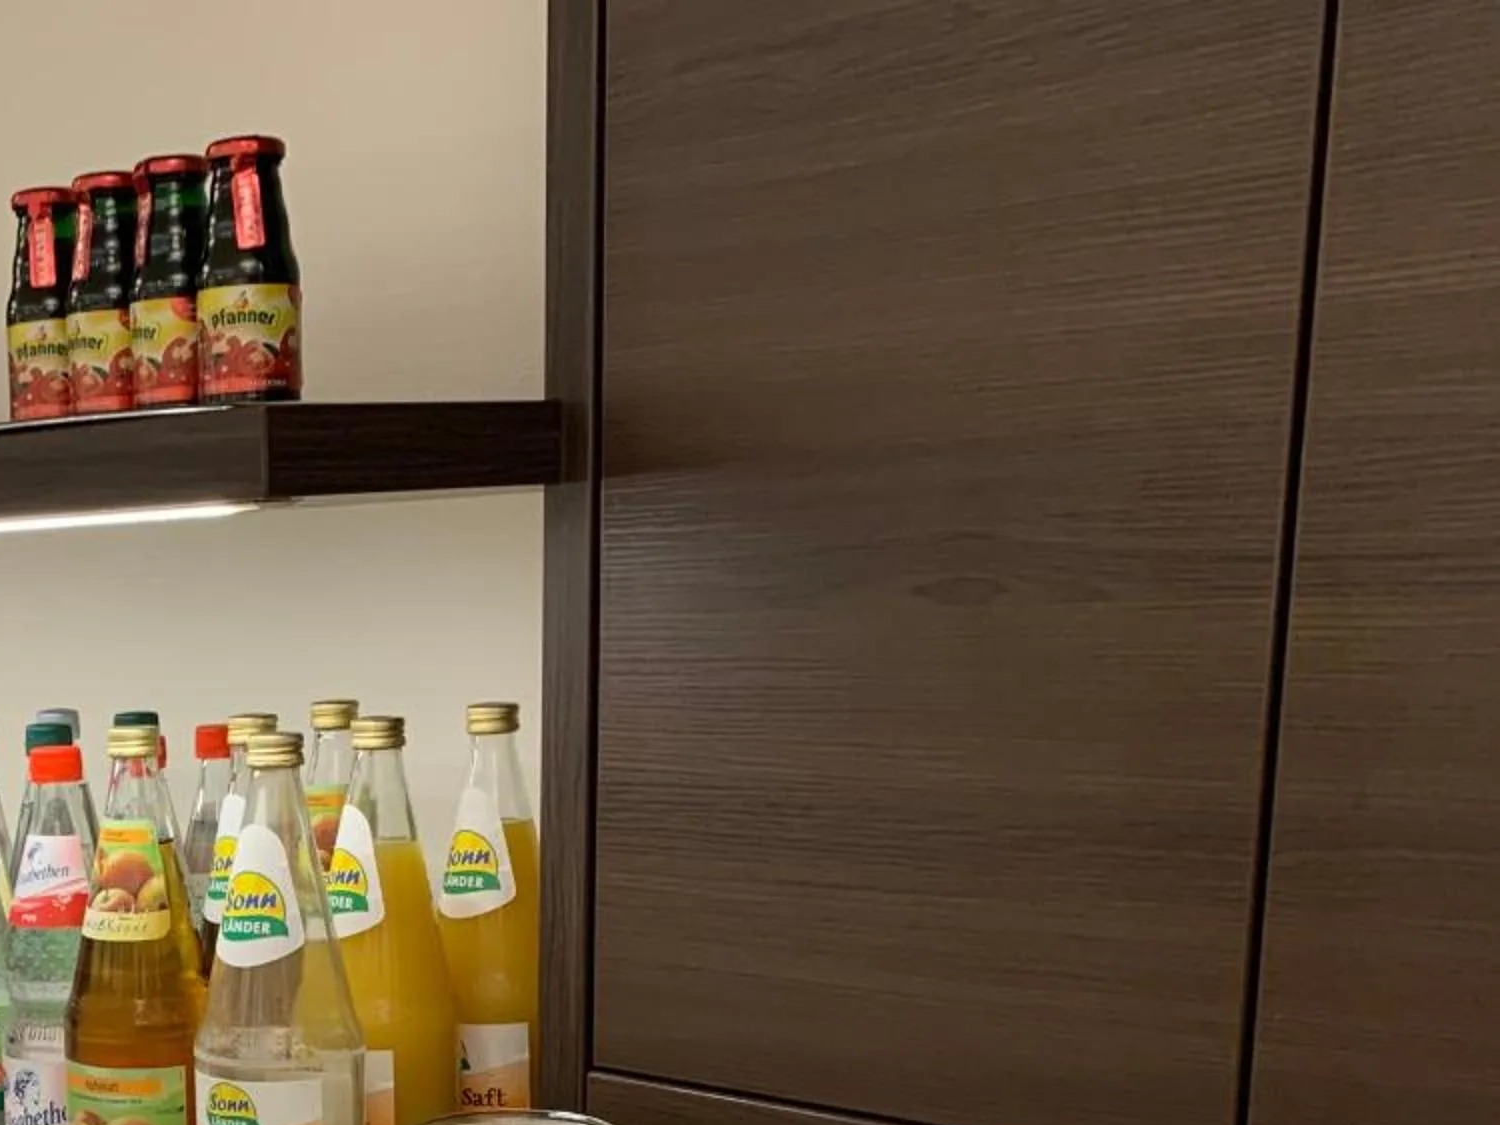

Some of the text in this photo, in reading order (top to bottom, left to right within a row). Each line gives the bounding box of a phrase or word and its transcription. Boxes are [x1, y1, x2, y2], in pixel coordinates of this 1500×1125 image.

[211, 307, 275, 329] pfanner
[16, 342, 68, 358] pfanne
[461, 1086, 509, 1107] Saft
